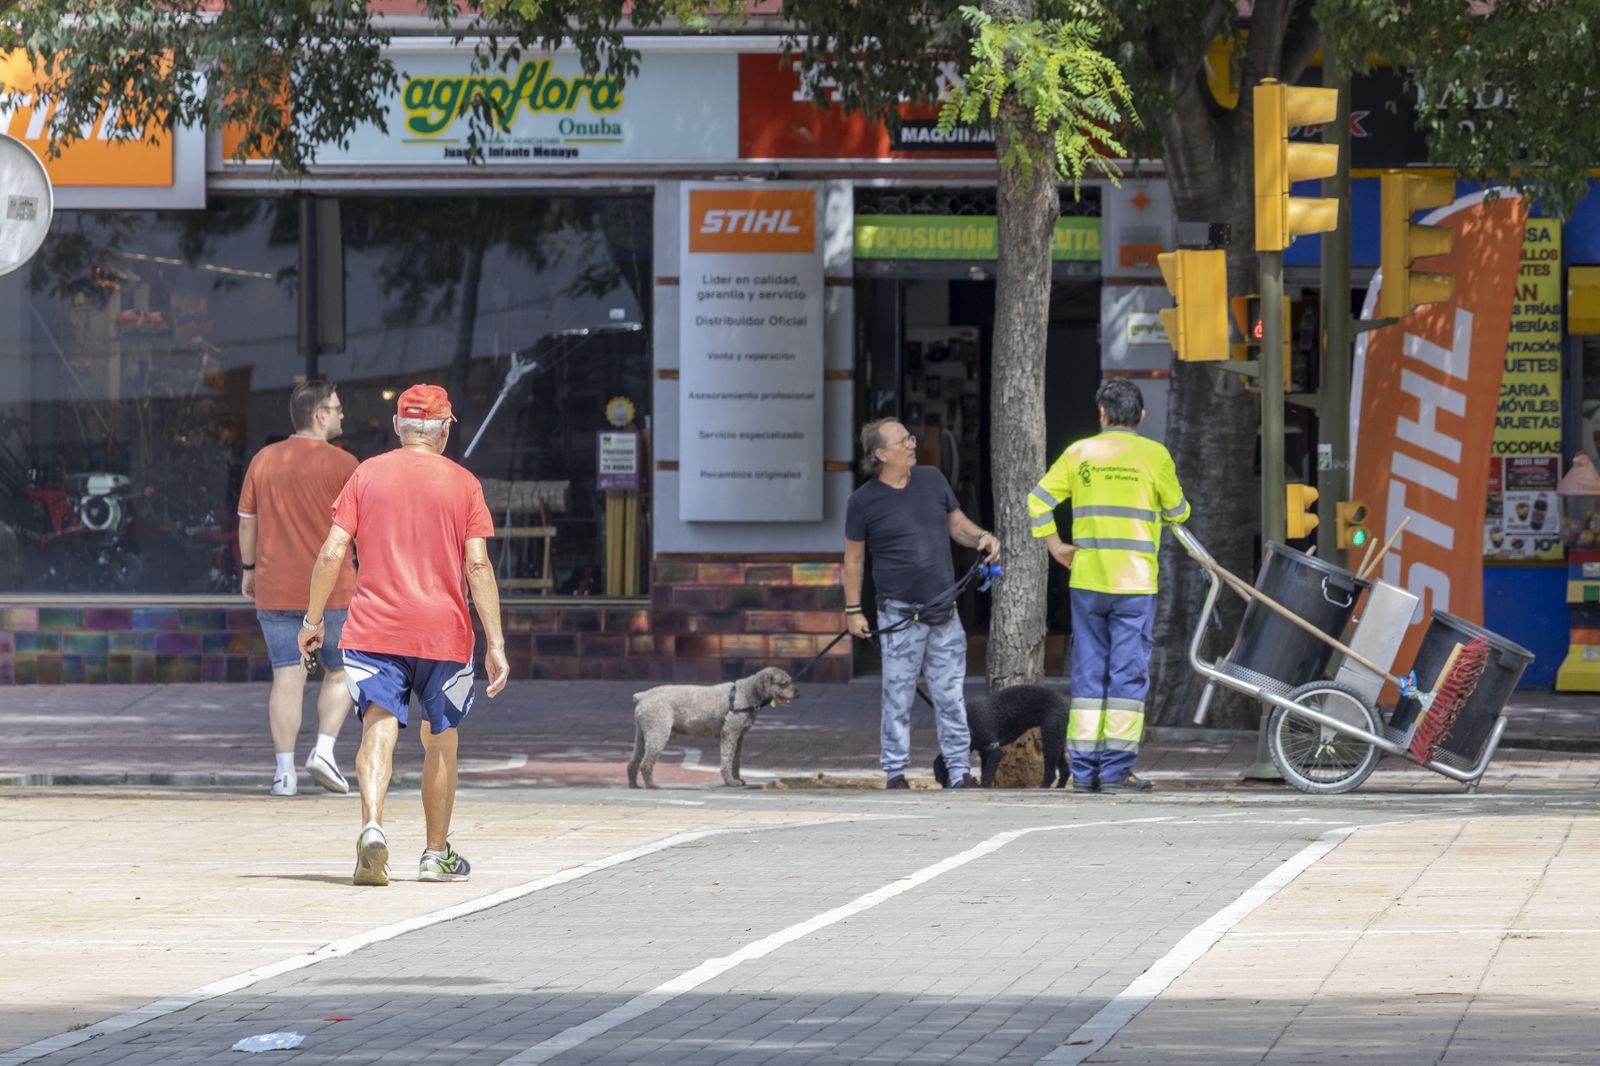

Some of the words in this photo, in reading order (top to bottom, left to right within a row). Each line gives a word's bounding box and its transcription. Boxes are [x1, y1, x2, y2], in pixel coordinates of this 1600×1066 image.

[403, 58, 622, 136] agroflora
[559, 118, 621, 135] Onuba
[699, 209, 801, 234] STIHL
[1526, 227, 1551, 243] SA
[735, 277, 750, 286] en
[748, 291, 756, 302] y
[758, 289, 806, 300] servicio
[695, 314, 765, 327] Distribuidor
[767, 314, 808, 327] Oficial
[707, 352, 735, 361] Venta
[761, 391, 815, 402] profesional
[698, 430, 737, 440] Servicio
[739, 430, 805, 442] especializado
[1383, 306, 1474, 625] STIHL
